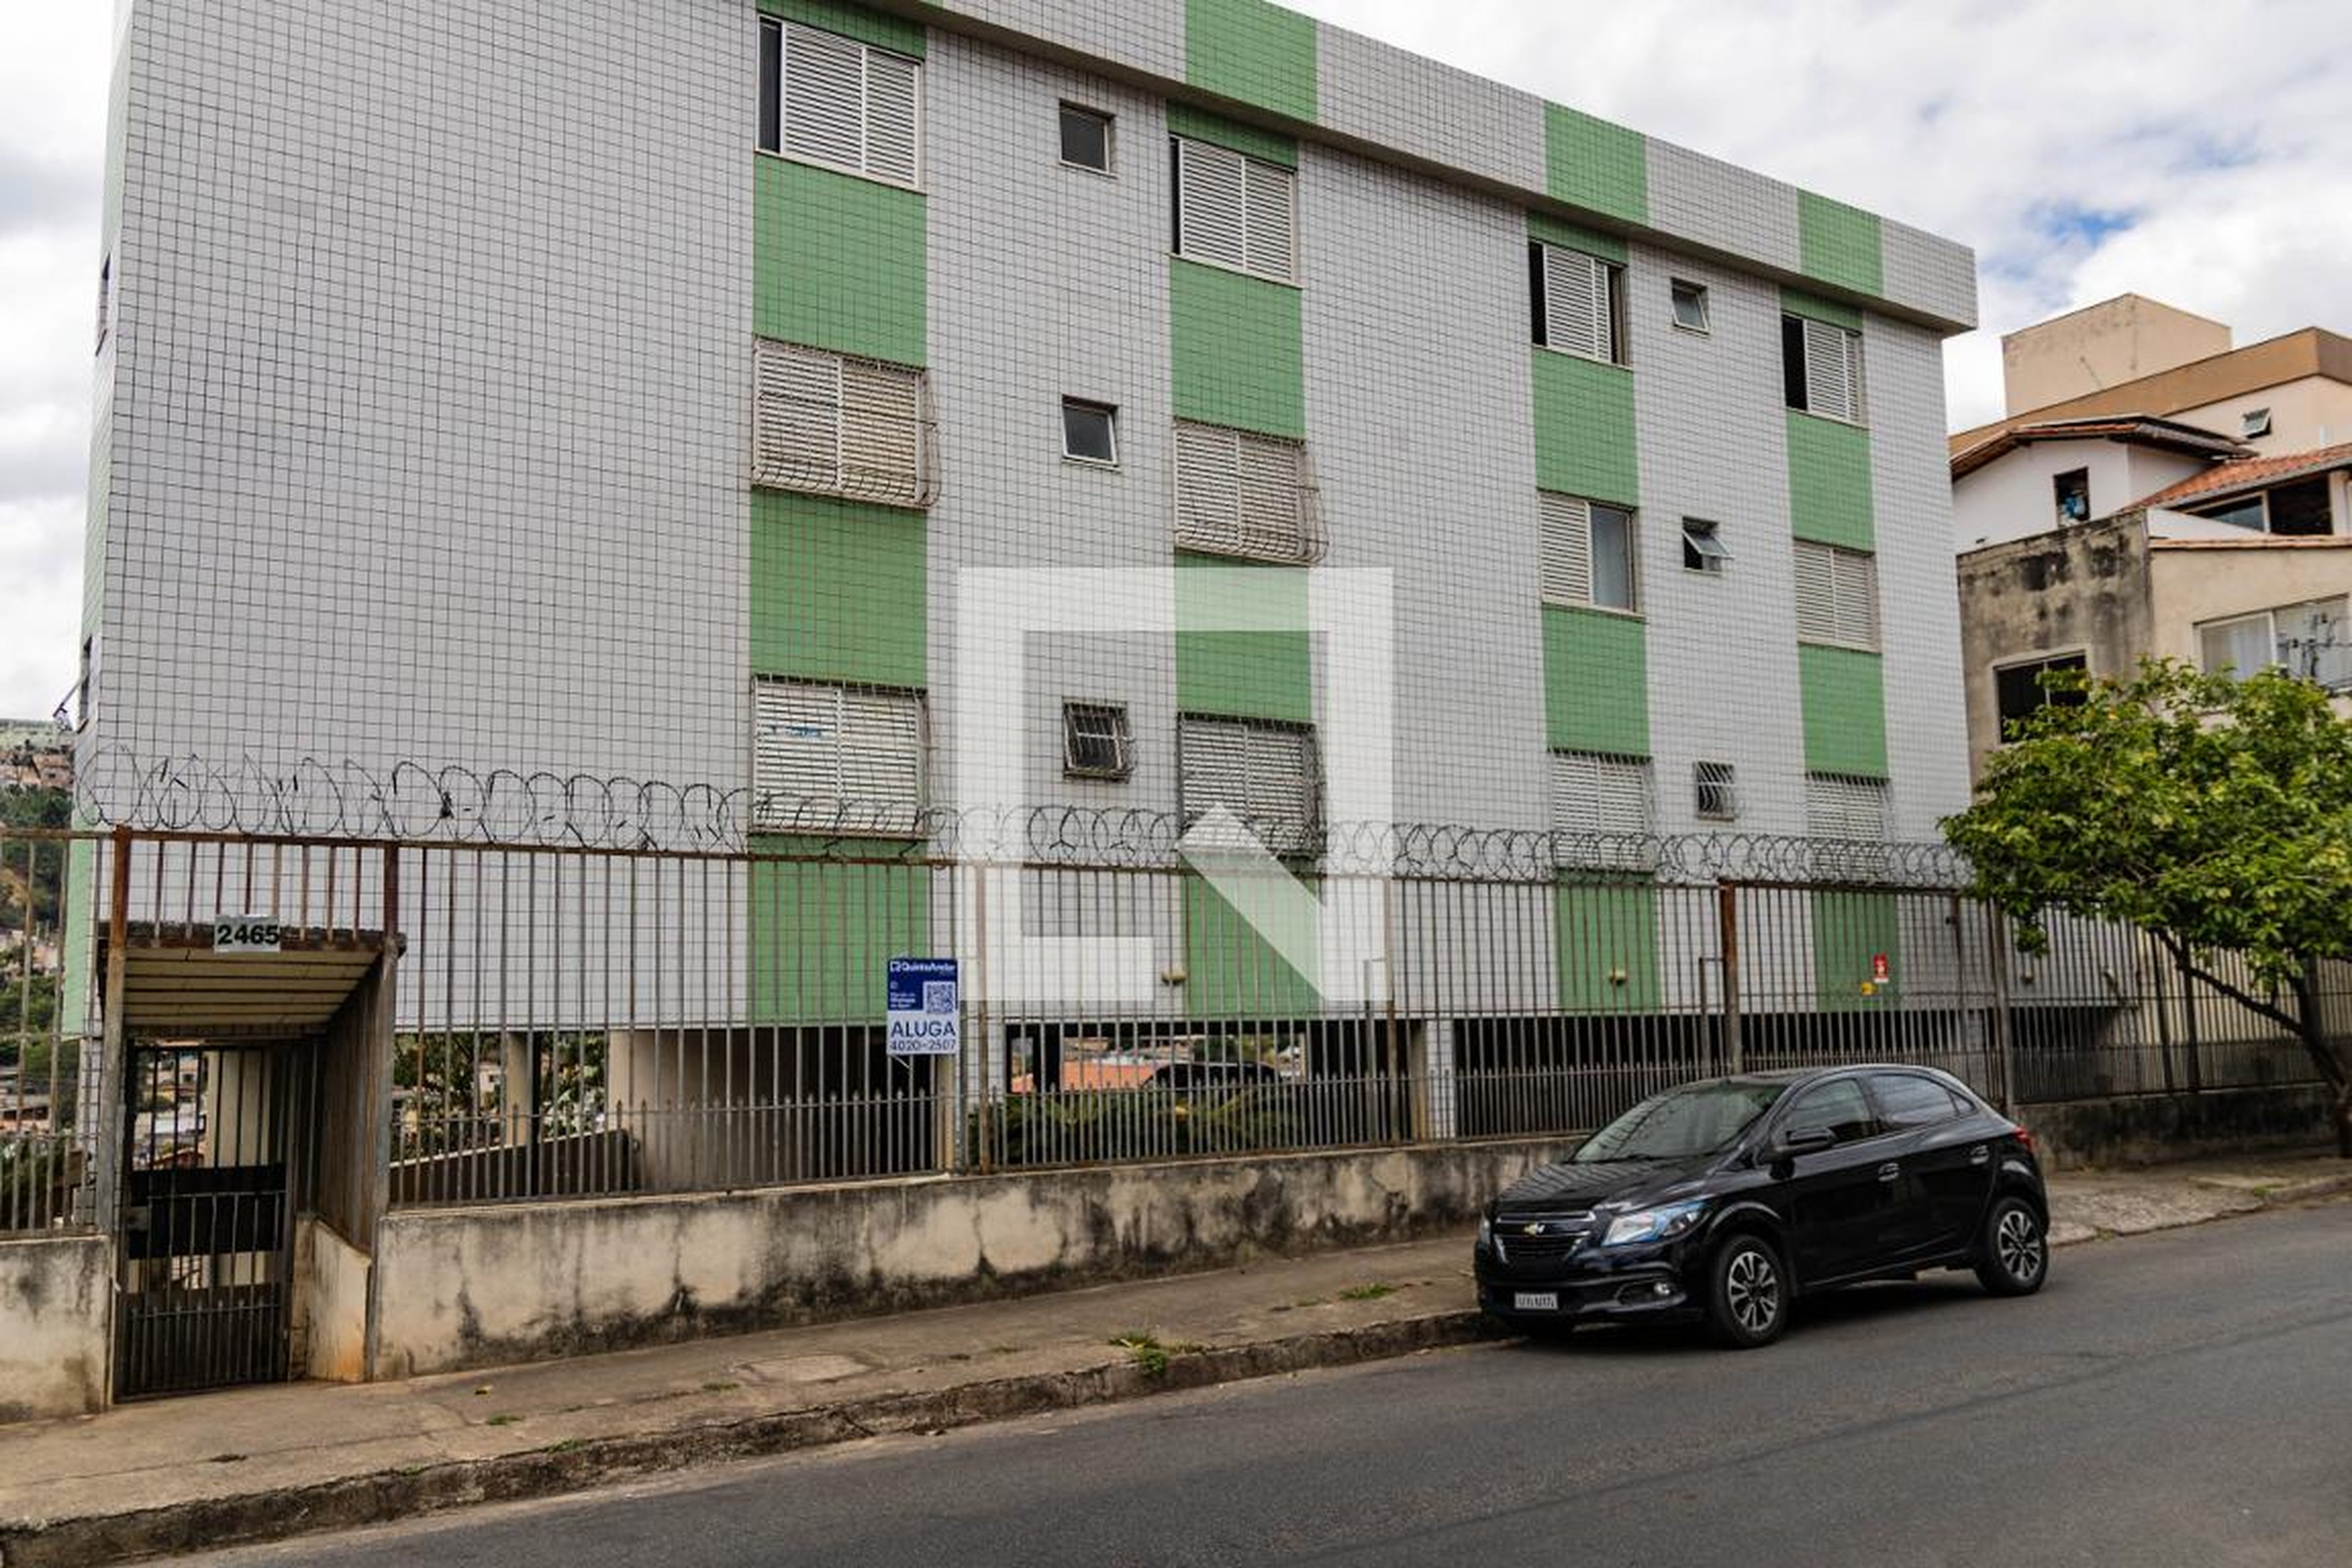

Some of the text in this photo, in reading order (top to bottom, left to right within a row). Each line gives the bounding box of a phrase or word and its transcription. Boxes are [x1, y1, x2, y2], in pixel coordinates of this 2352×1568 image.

[217, 924, 280, 945] 2465
[891, 1020, 956, 1038] ALUGA
[891, 1040, 956, 1050] 4020-2507
